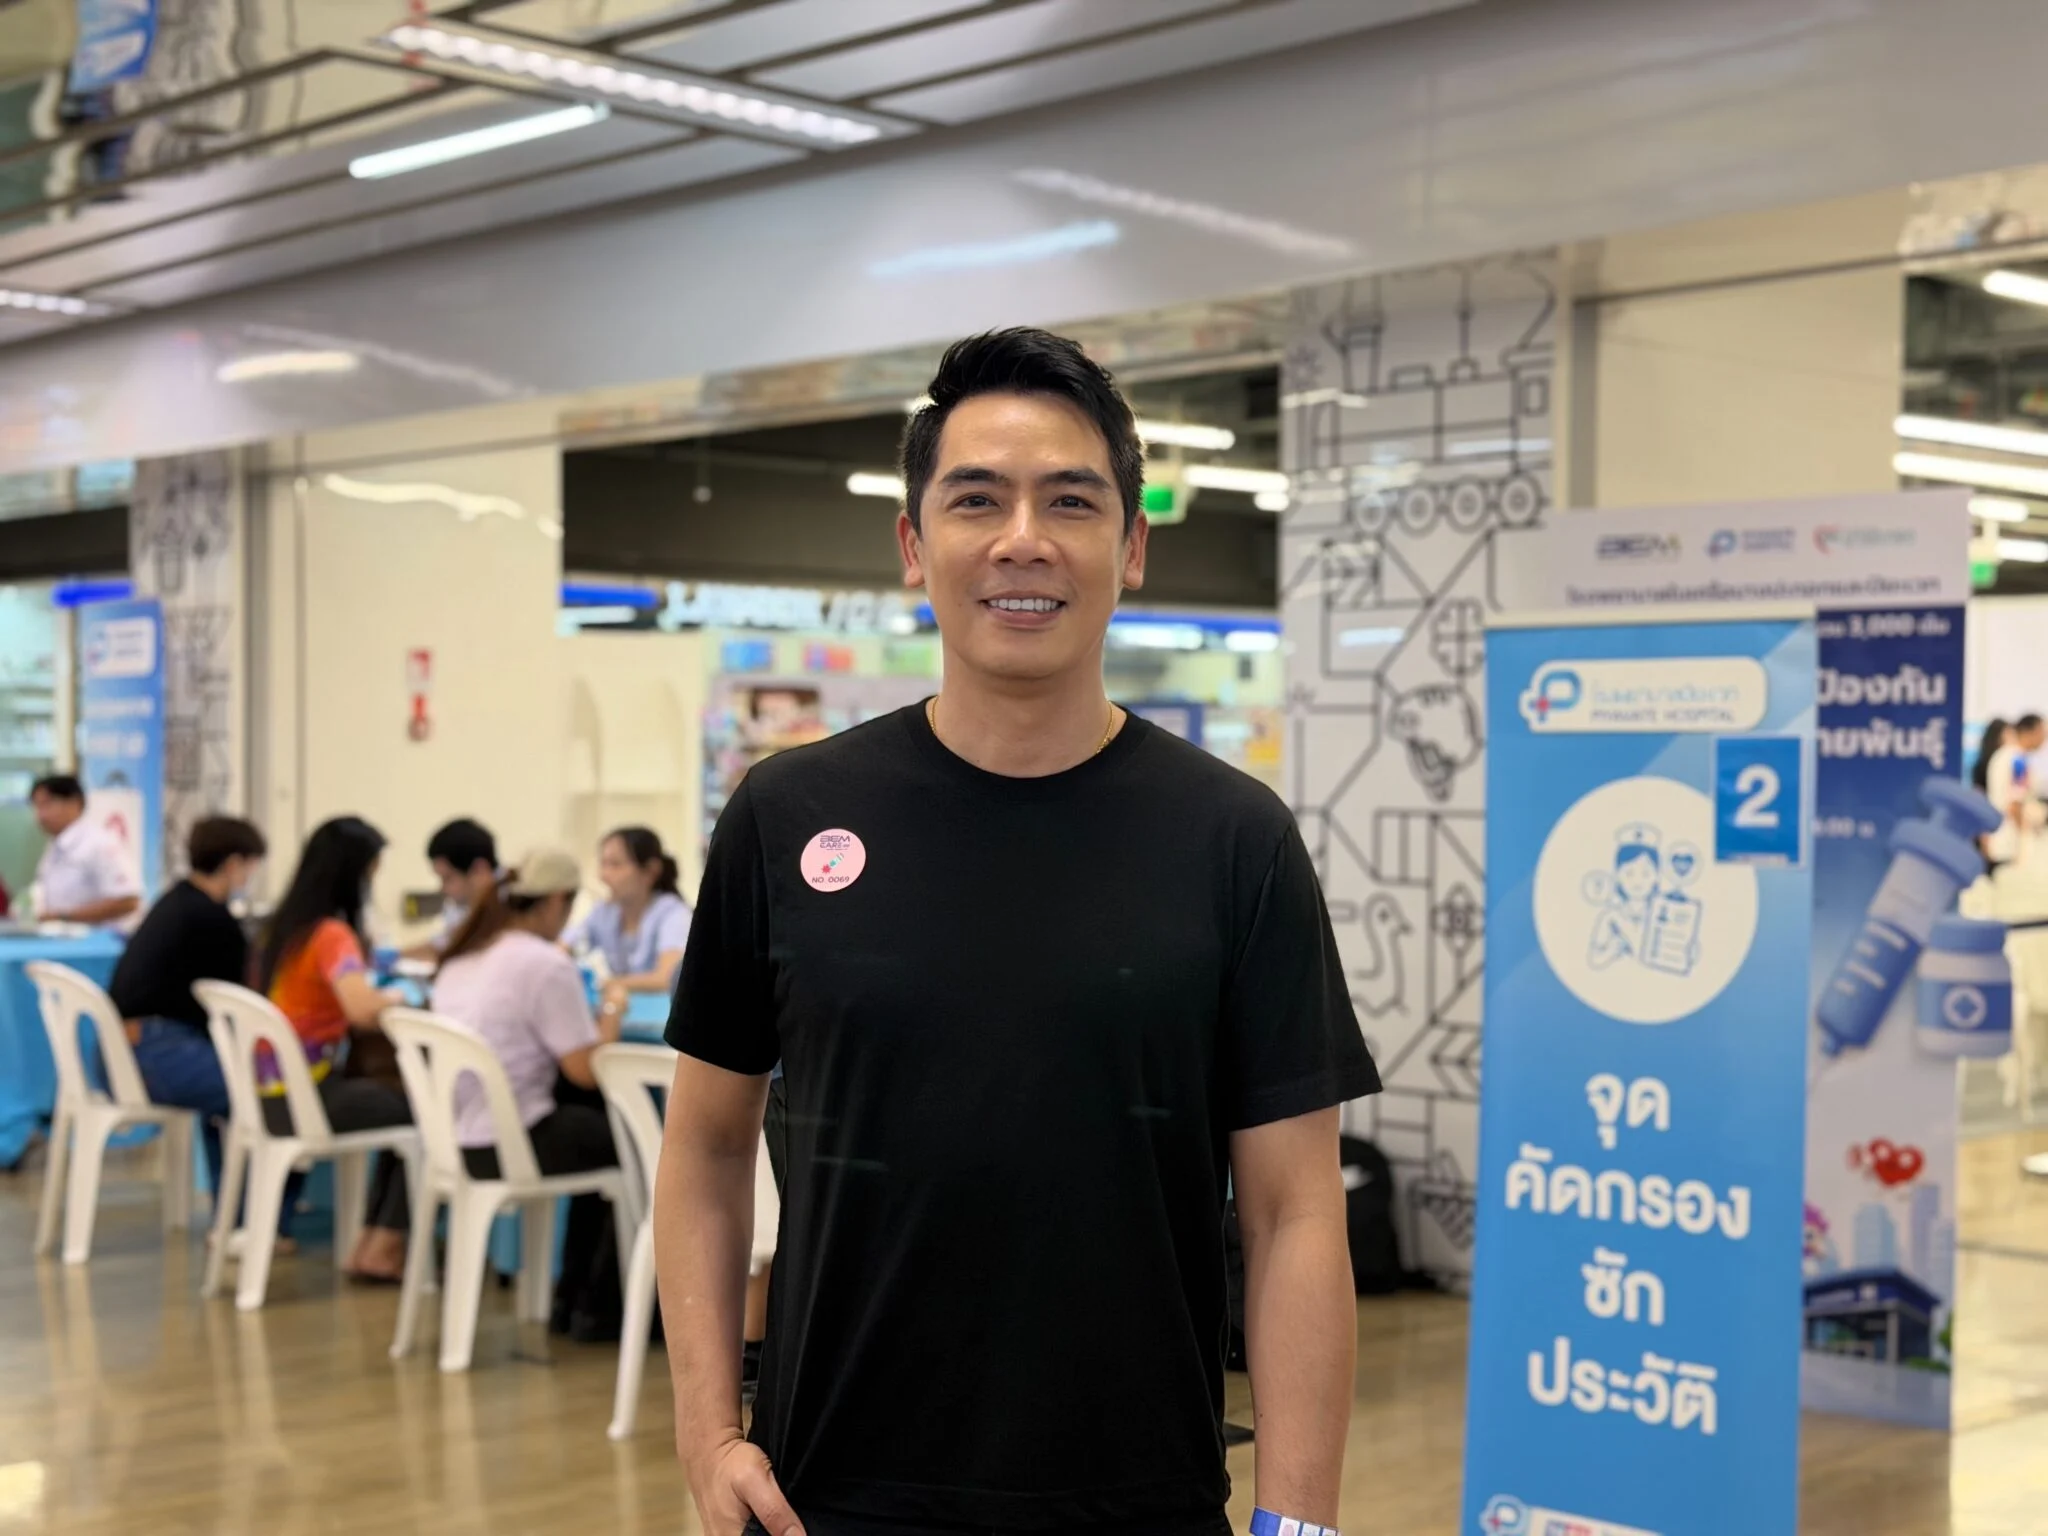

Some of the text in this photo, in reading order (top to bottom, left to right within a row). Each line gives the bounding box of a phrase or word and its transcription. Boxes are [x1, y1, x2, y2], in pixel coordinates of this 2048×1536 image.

[1734, 763, 1780, 828] 2
[1585, 1073, 1670, 1149] จุด
[1505, 1143, 1751, 1239] คัดกรอง
[1581, 1247, 1665, 1326] ซัก
[1528, 1336, 1718, 1435] ประวัติ
